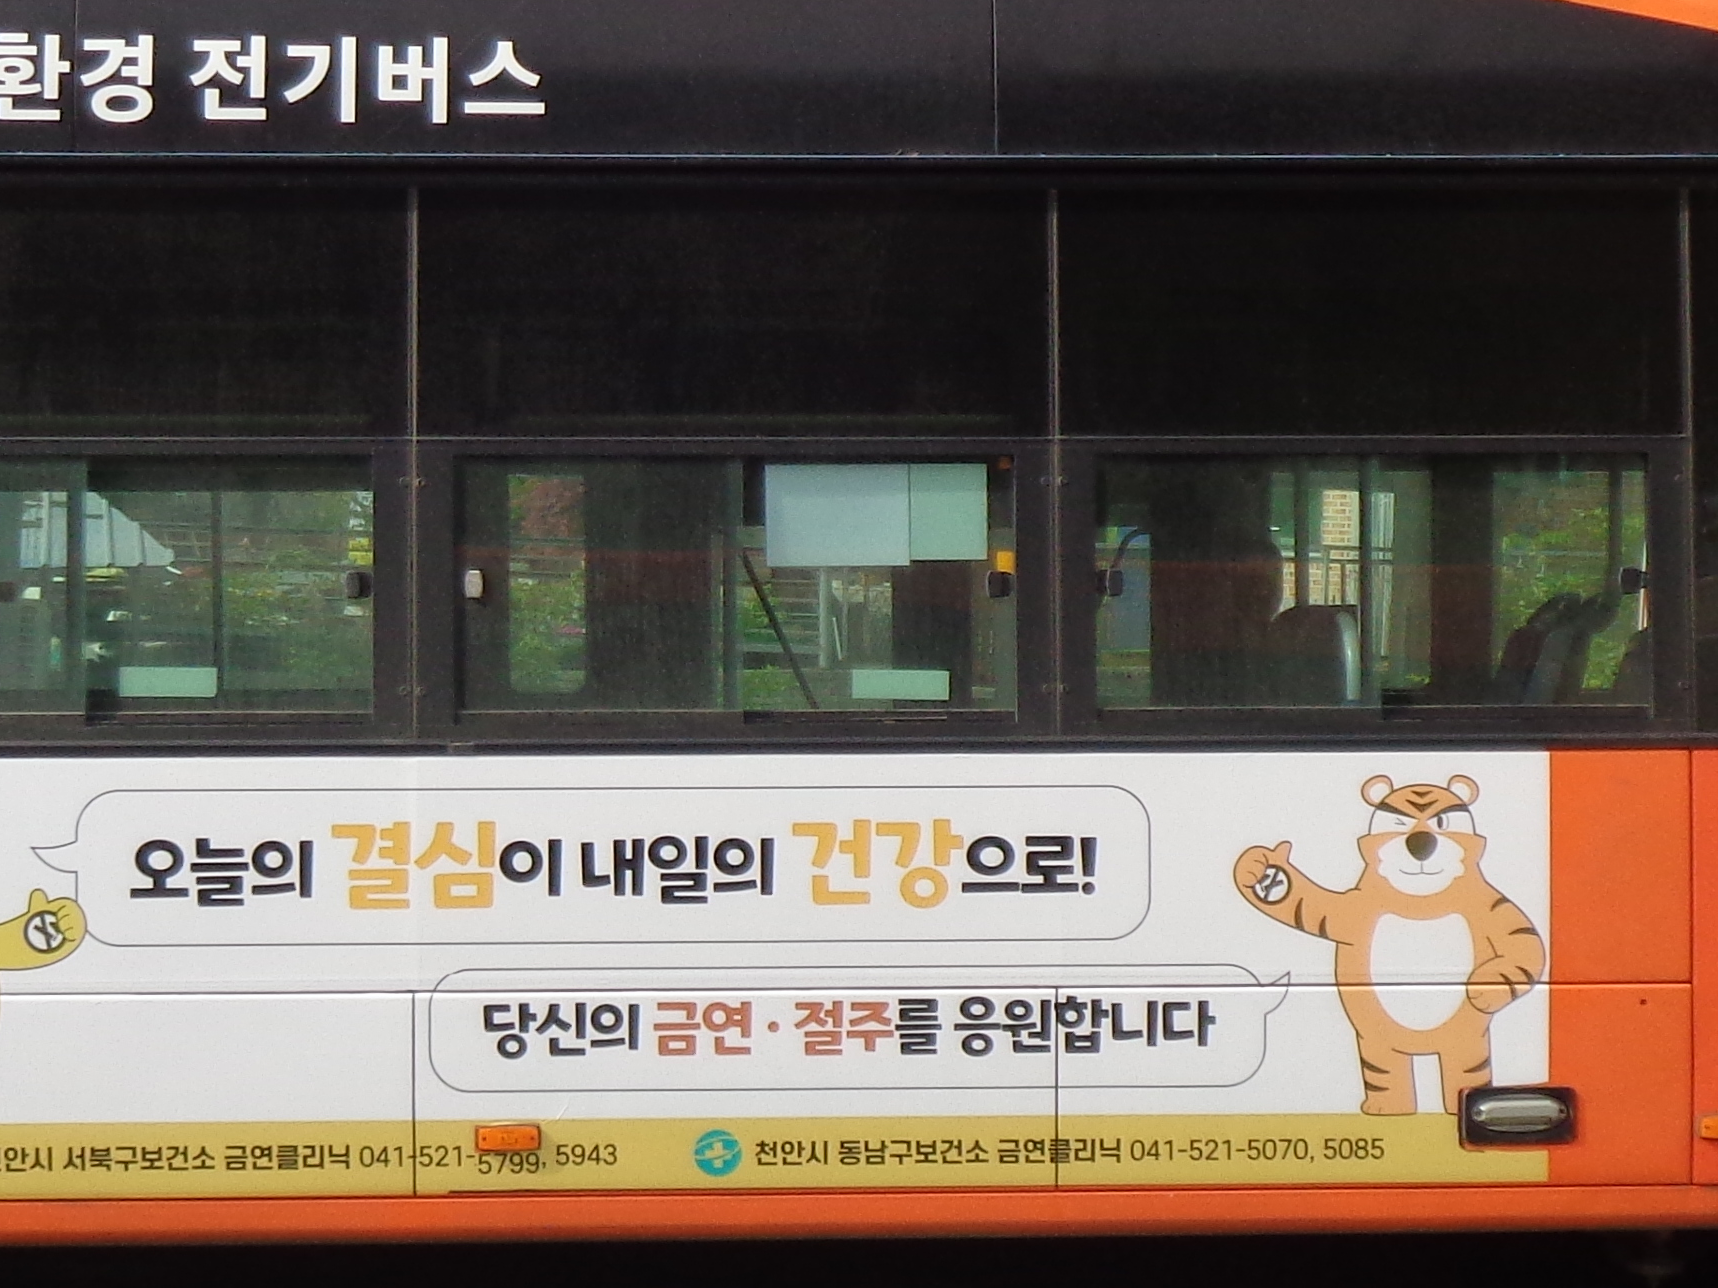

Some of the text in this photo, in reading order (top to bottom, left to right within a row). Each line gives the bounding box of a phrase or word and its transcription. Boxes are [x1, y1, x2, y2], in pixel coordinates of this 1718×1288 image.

[189, 34, 546, 124] 전기버스
[129, 818, 1097, 911] 오늘의 결심이 내일의 건강으로!
[483, 1001, 641, 1060] 당신의
[953, 995, 1217, 1059] 응원합니다
[63, 1145, 217, 1172] 서북구보건소
[224, 1144, 351, 1171] 금연클리닉
[555, 1143, 618, 1166] 5943
[754, 1138, 1386, 1166] 천안시 동남구보건소 금연클리닉 041-521-5070, 5085
